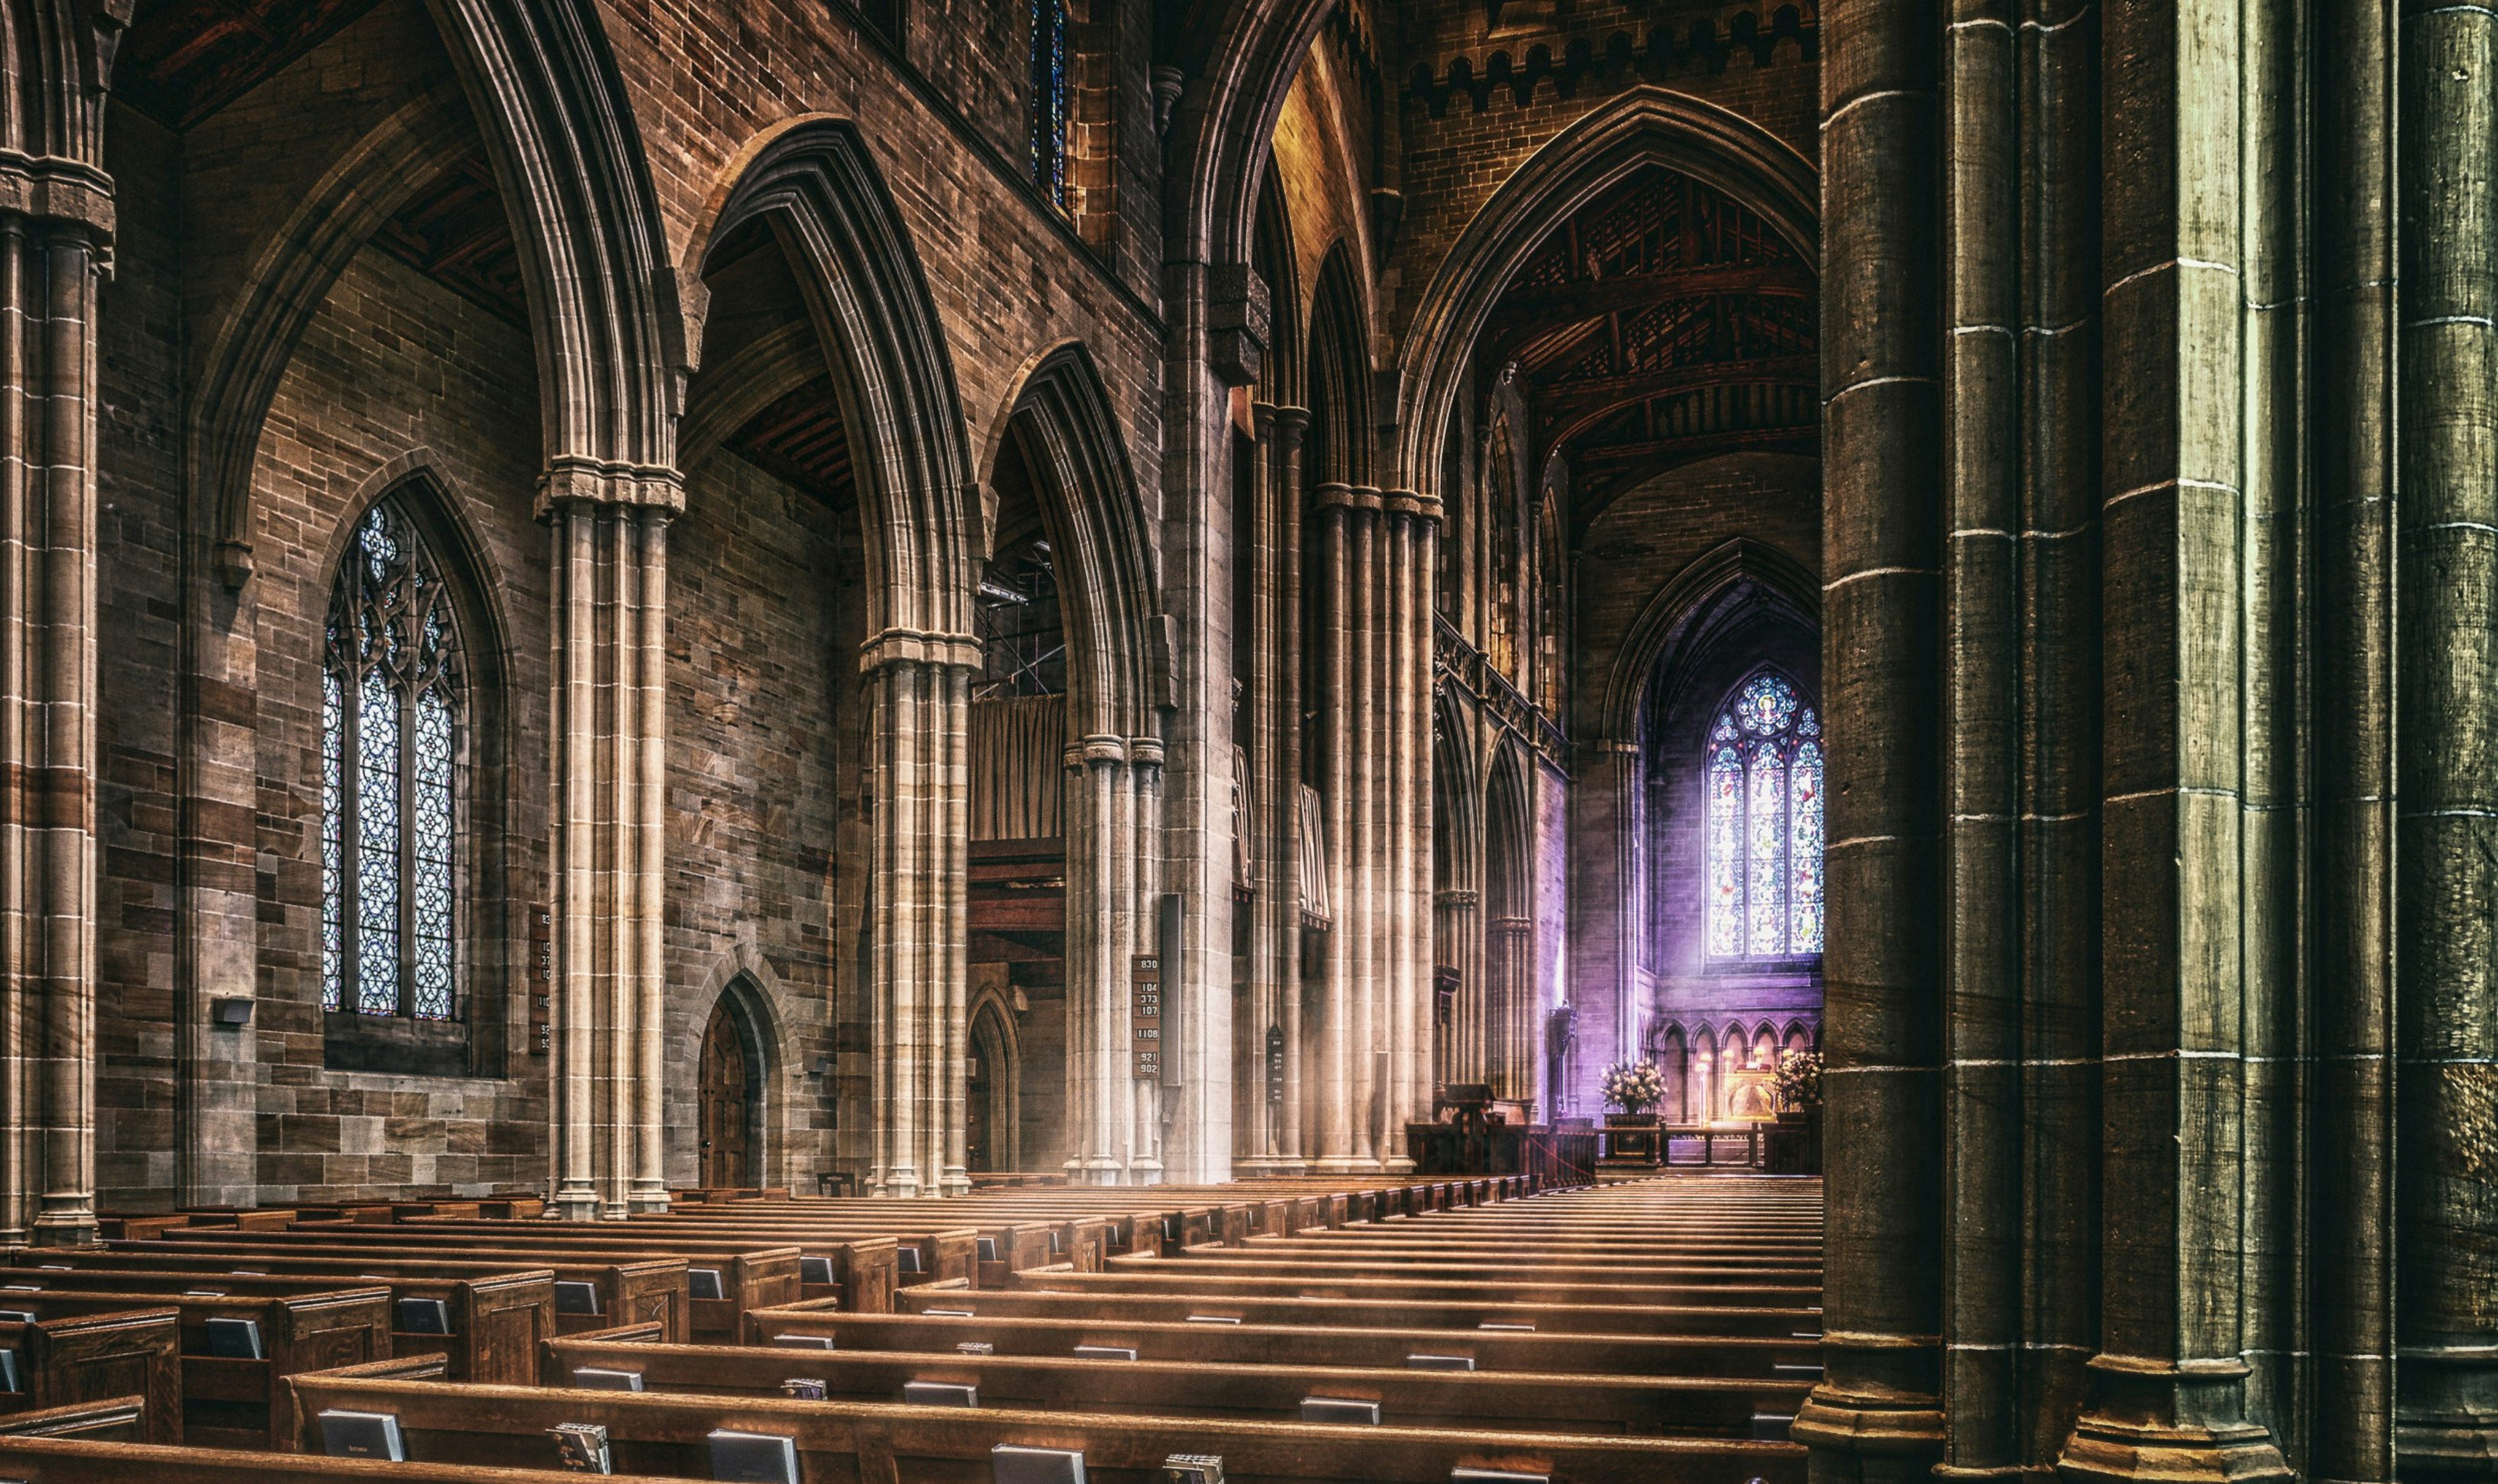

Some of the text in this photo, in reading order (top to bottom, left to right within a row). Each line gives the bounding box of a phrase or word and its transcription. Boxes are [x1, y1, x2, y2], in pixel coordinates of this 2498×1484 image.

[1142, 960, 1158, 969] 830
[1142, 983, 1157, 992] 104
[1141, 994, 1158, 1003] 373
[1142, 1006, 1158, 1015] 107
[1138, 1029, 1158, 1038] 1108
[1141, 1053, 1156, 1061] 921
[1140, 1064, 1157, 1073] 902
